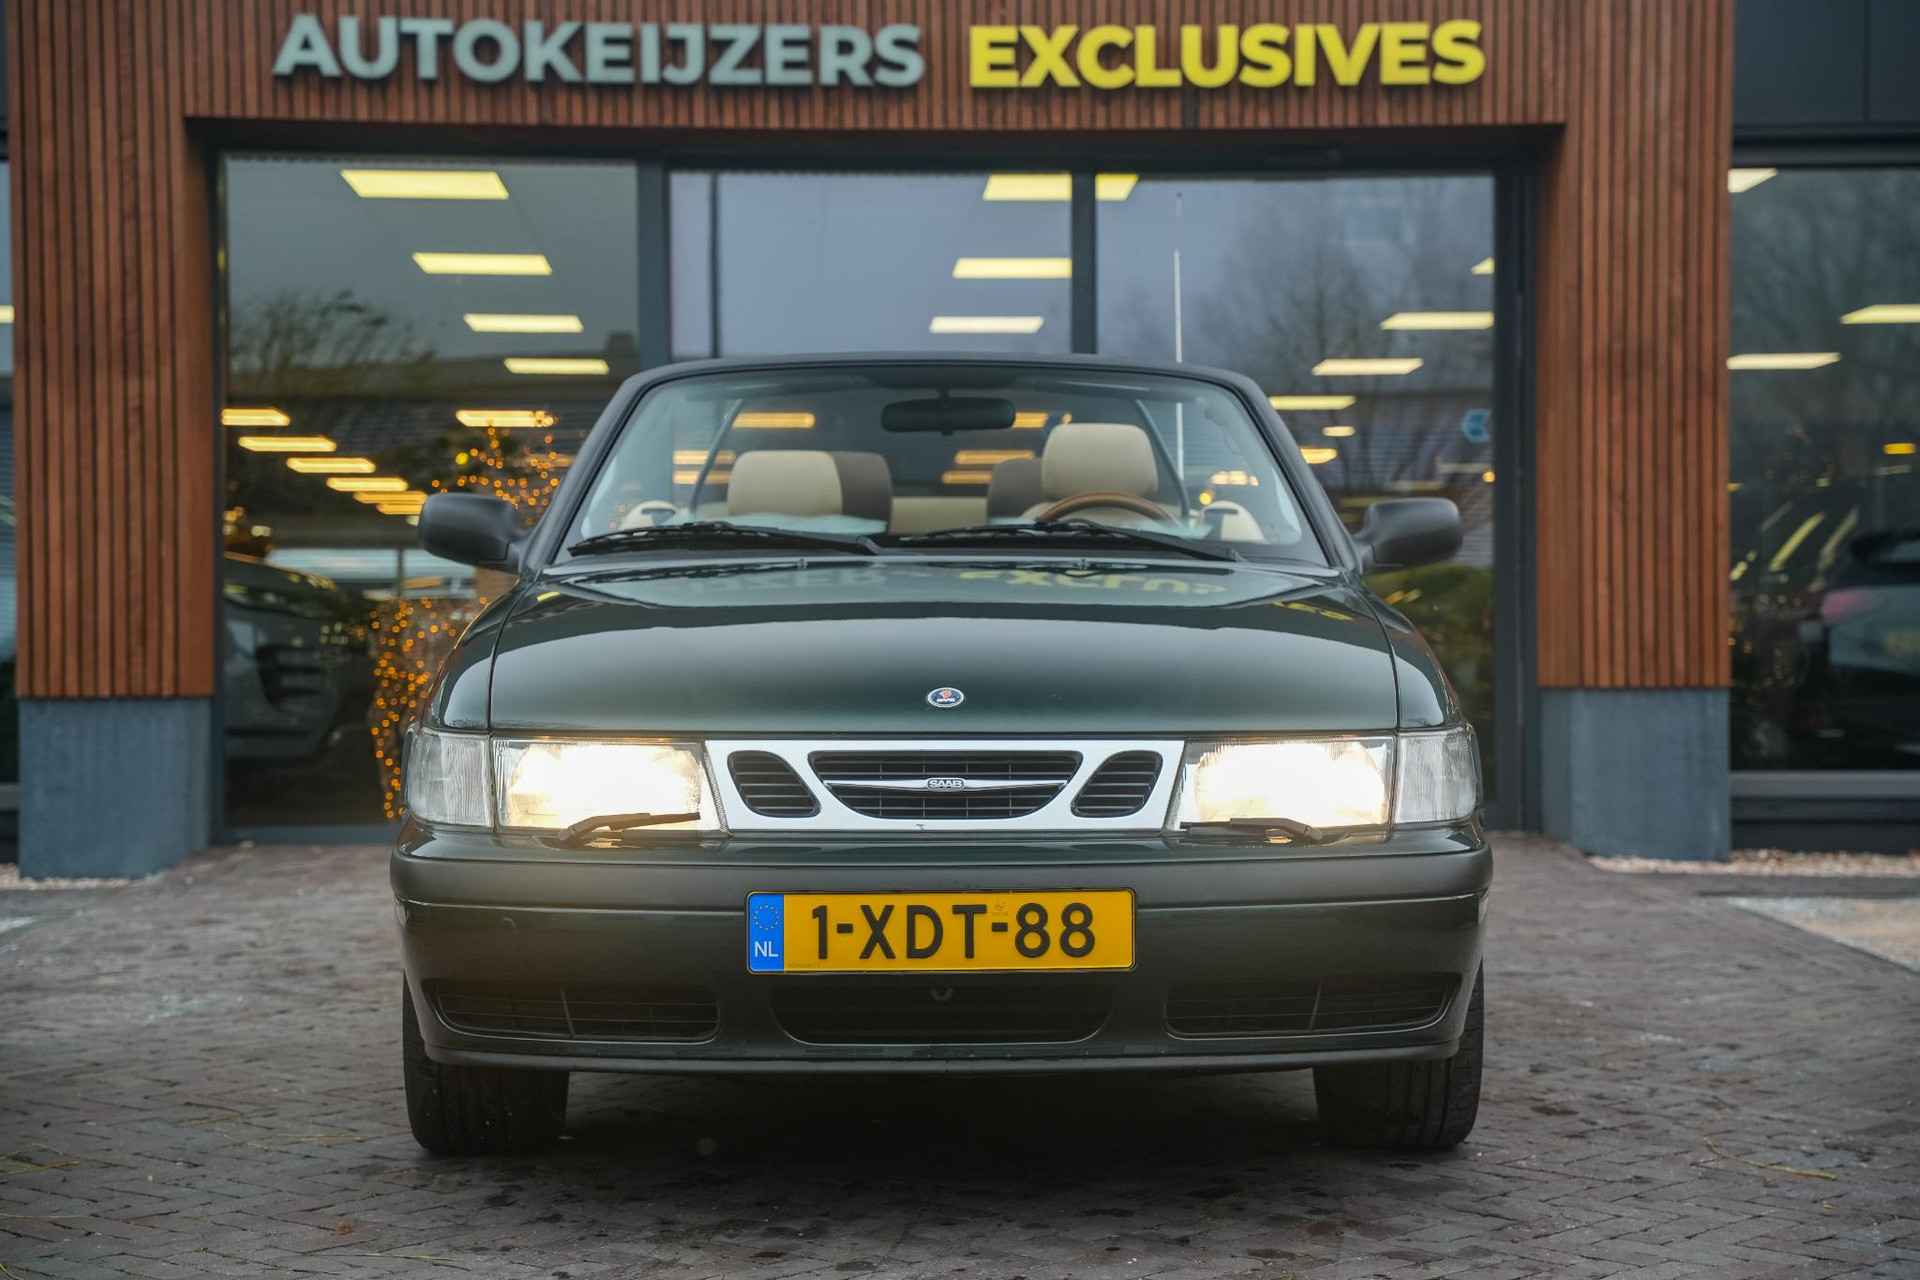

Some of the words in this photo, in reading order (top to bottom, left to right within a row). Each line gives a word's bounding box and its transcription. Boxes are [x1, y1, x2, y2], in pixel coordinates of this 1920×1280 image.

[273, 13, 925, 87] AUTOKEIJZERS
[969, 20, 1486, 89] EXCLUSIVES
[928, 780, 963, 788] SAAB
[754, 940, 779, 958] NL
[811, 902, 1096, 960] 1-XDT-88
